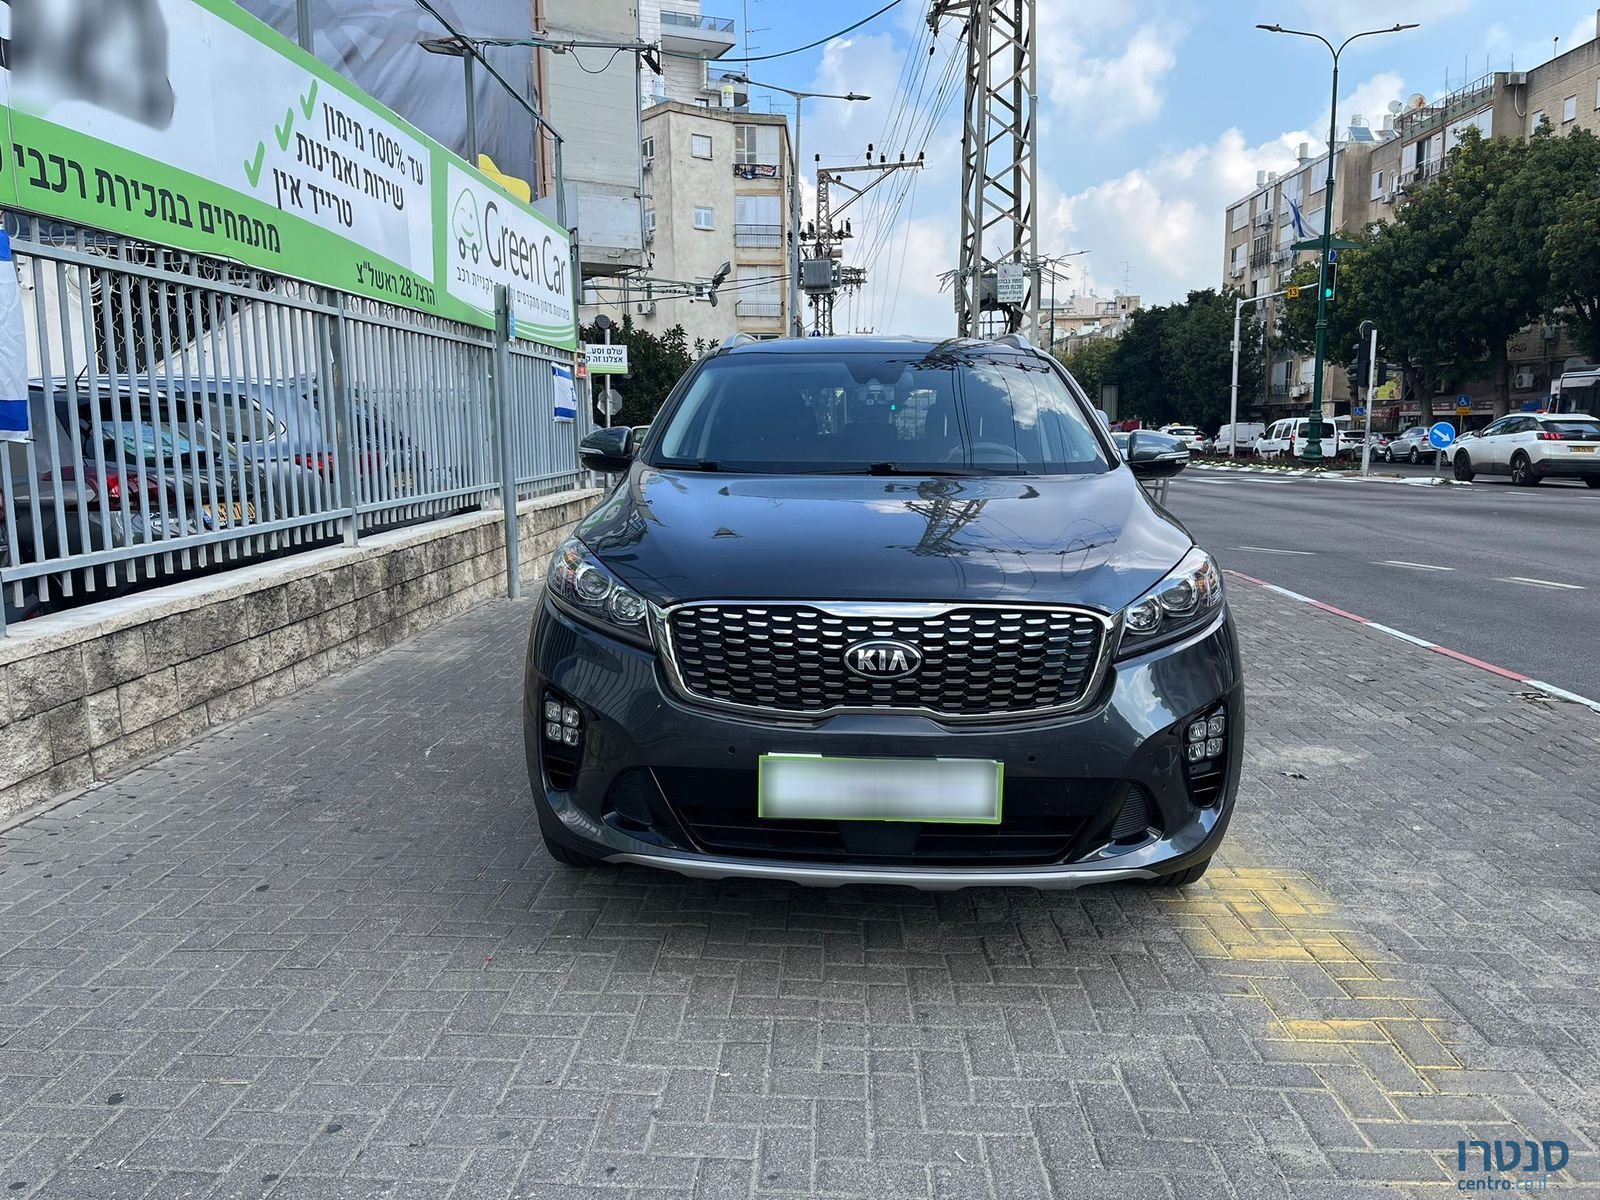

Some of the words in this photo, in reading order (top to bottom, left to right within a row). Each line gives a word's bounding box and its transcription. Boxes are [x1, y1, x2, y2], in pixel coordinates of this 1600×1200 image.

[323, 102, 365, 152] מימון
[13, 142, 87, 199] רכבי
[296, 132, 360, 190] ואמינות
[368, 128, 405, 175] 100%
[408, 155, 423, 185] עד
[95, 167, 193, 228] במכירת
[273, 168, 303, 210] אין
[307, 183, 353, 228] טרייד
[363, 168, 404, 210] שירות
[198, 201, 281, 253] מתמחים
[484, 201, 540, 285] Green
[543, 235, 566, 296] Car
[400, 274, 412, 298] 28
[413, 277, 435, 306] הרצל
[456, 266, 470, 284] רכב
[472, 273, 493, 295] לקניית
[857, 649, 909, 671] KIA
